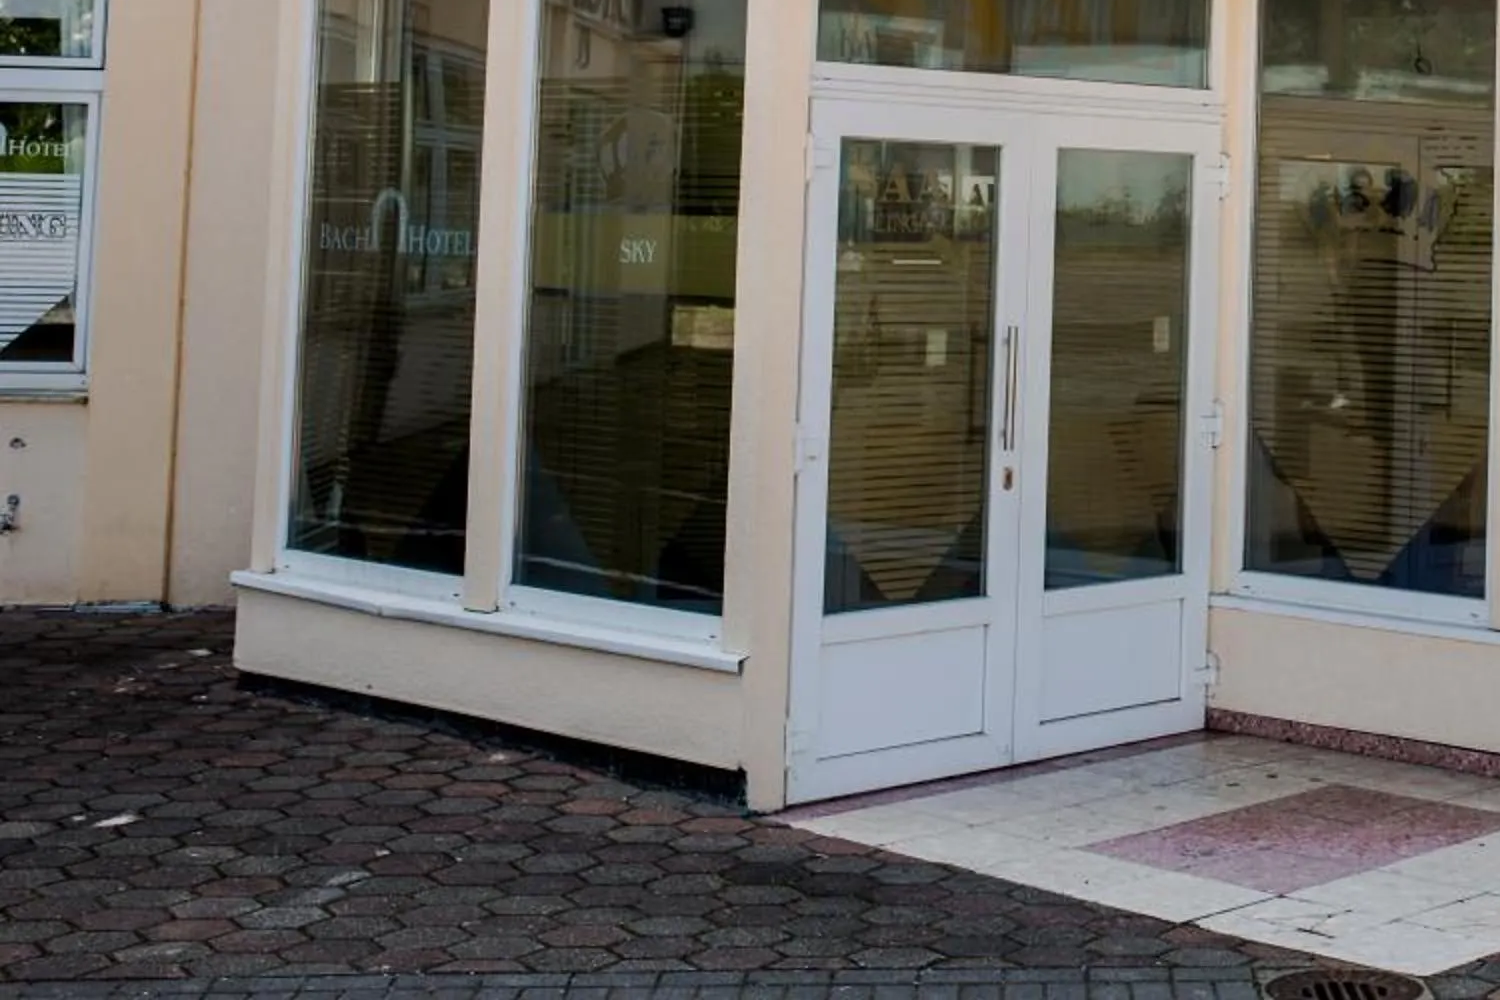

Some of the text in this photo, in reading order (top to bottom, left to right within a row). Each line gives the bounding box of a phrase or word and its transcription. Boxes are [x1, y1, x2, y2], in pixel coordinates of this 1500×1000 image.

[320, 222, 475, 256] BACH HOTEL
[619, 237, 657, 263] SKY
